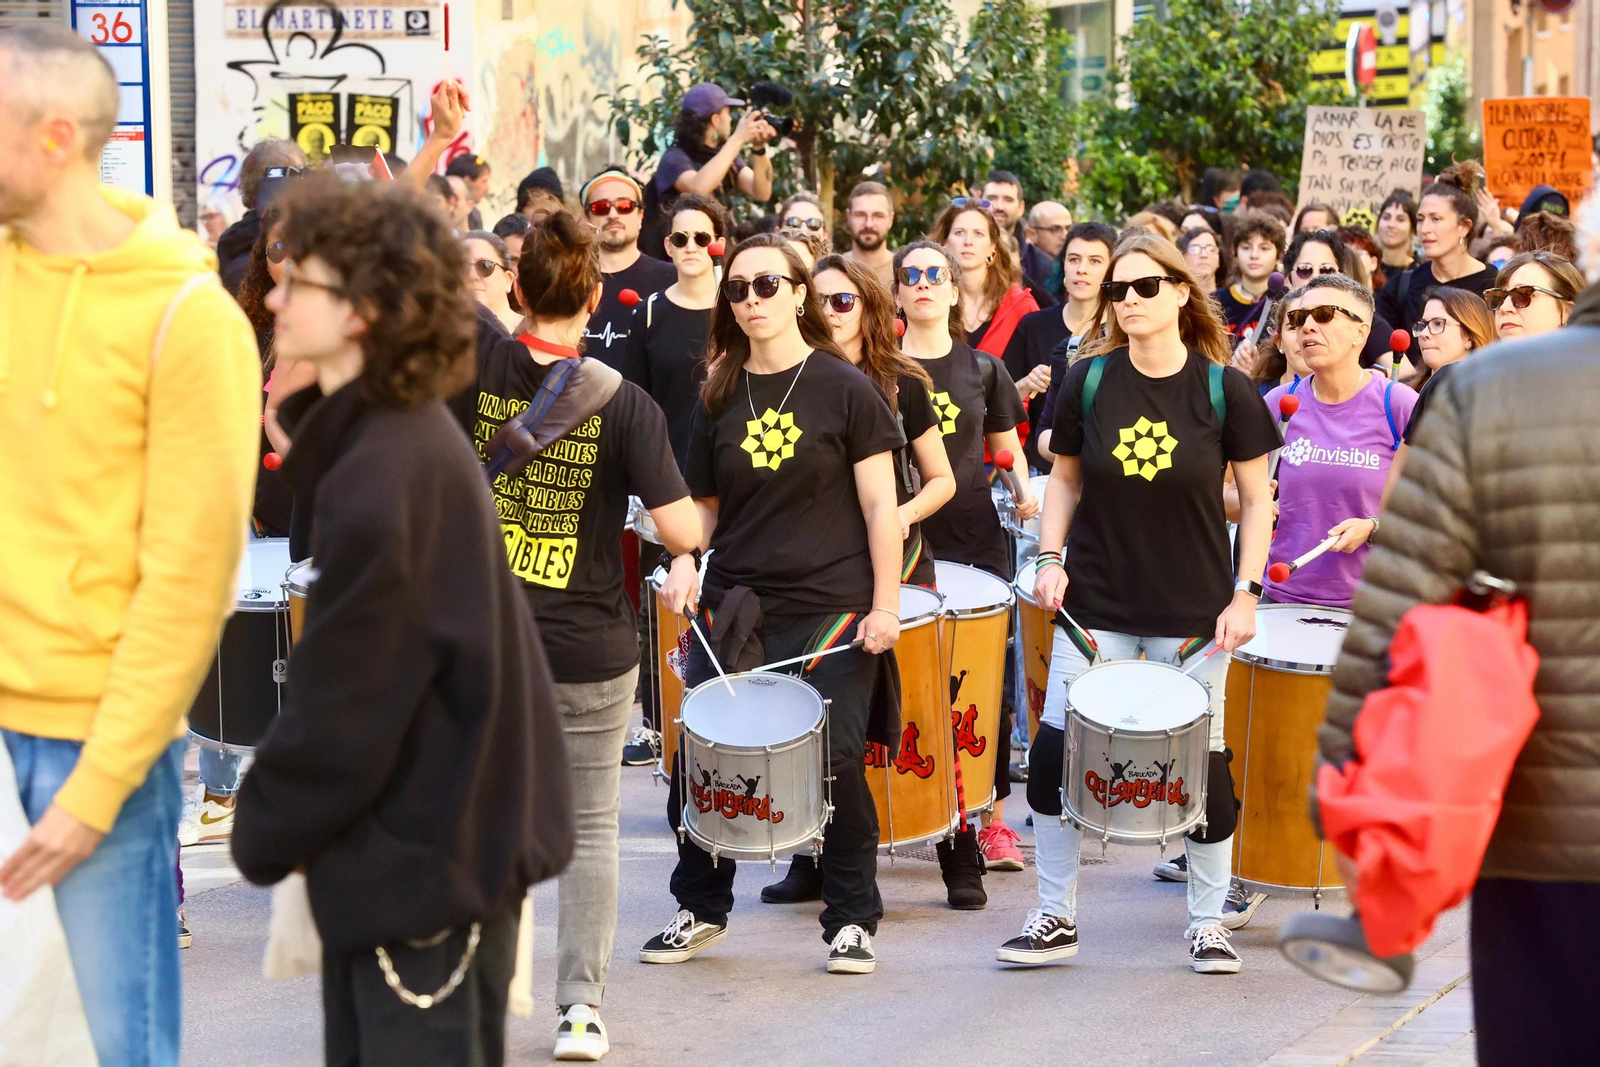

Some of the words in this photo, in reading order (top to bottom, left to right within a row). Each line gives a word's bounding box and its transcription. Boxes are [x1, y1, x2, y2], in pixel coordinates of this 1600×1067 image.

[91, 11, 133, 44] 36
[237, 9, 263, 29] EL
[297, 101, 334, 116] PACO
[355, 103, 393, 118] PACO
[1375, 112, 1394, 132] LA
[1313, 131, 1343, 148] DIOS
[1353, 133, 1373, 149] ES
[1339, 154, 1384, 171] TENER
[1306, 173, 1332, 190] TAN
[1311, 444, 1380, 466] invisible
